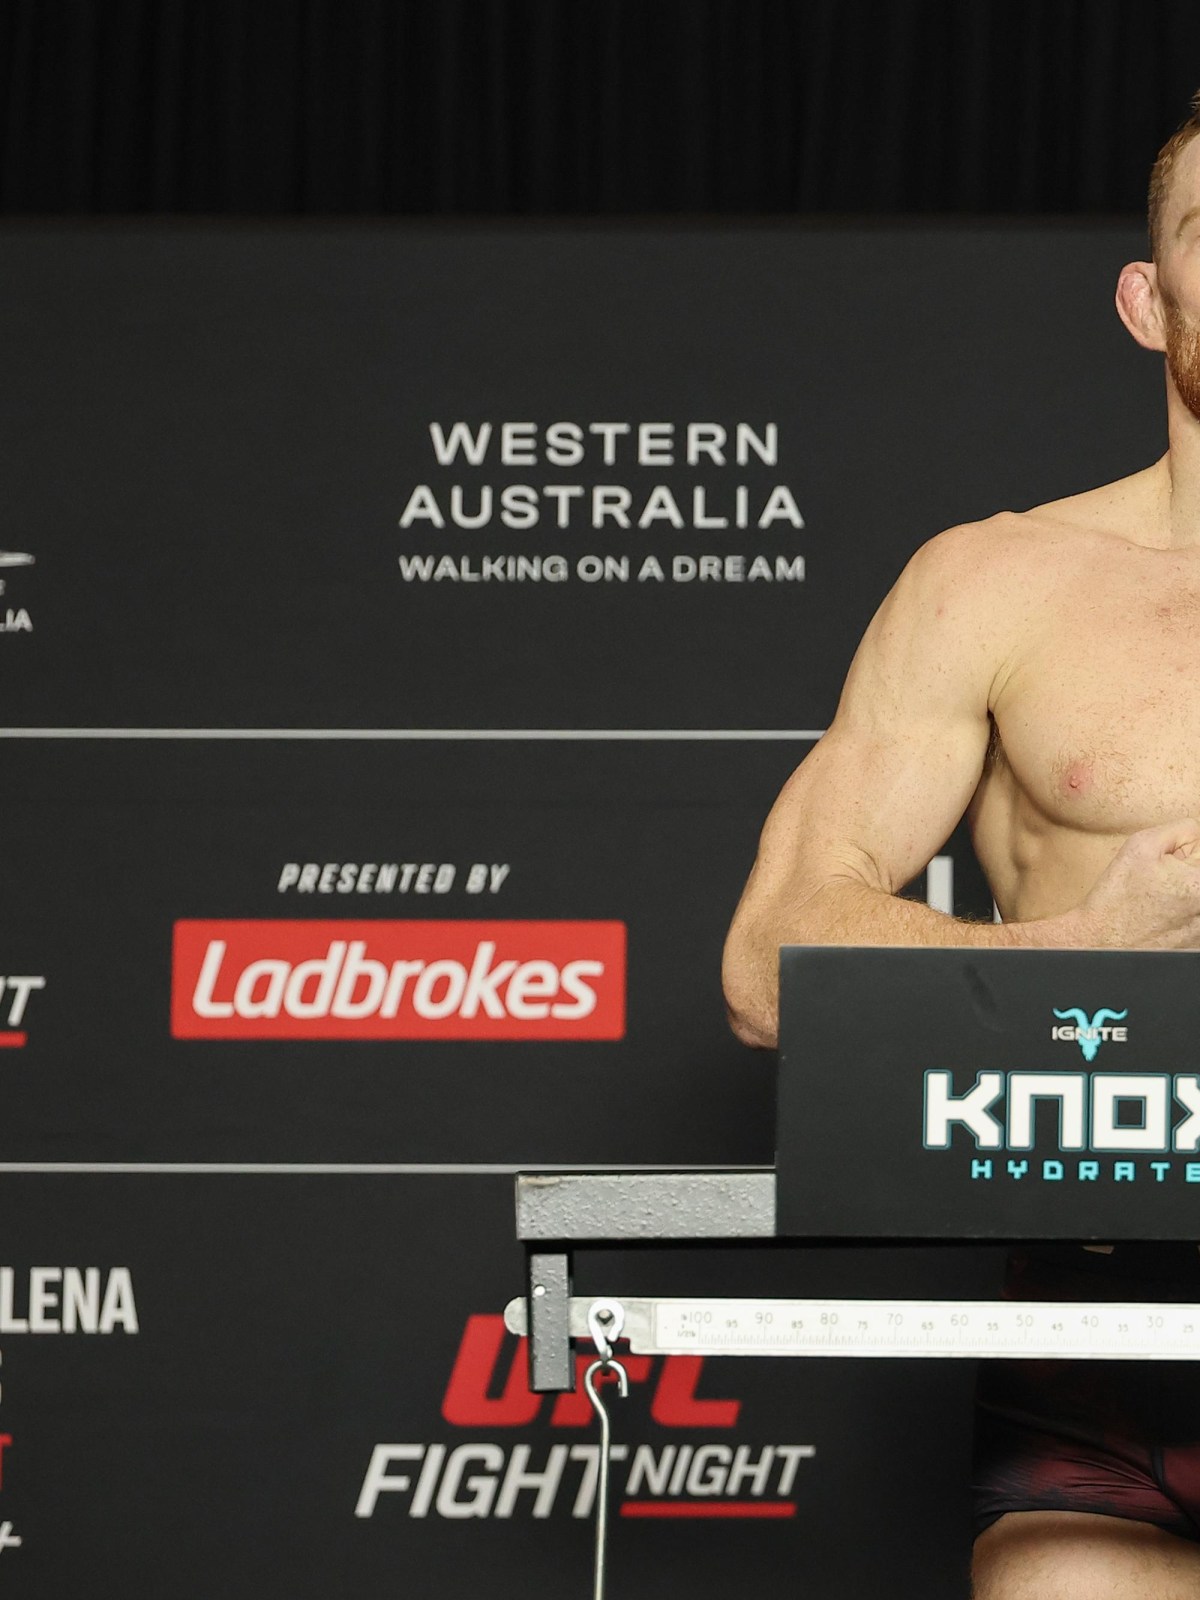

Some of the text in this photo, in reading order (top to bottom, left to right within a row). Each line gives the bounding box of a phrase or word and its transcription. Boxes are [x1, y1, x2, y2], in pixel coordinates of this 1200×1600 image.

[430, 421, 778, 467] WESTERN
[400, 485, 805, 529] AUSTRALIA
[399, 555, 806, 583] WALKING ON A DREAM
[278, 863, 510, 894] PRESENTED BY
[192, 940, 606, 1020] Ladbrokes
[1051, 1025, 1129, 1042] IGNITE
[689, 1311, 712, 1324] 100
[726, 1319, 738, 1328] 95
[755, 1312, 773, 1324] 90
[820, 1313, 839, 1325] 80
[887, 1313, 903, 1326] 70
[950, 1314, 969, 1326] 60
[1015, 1314, 1034, 1327] 50
[1081, 1315, 1099, 1328] 40
[1147, 1315, 1164, 1328] 30
[356, 1443, 815, 1518] FIGHT NIGHT
